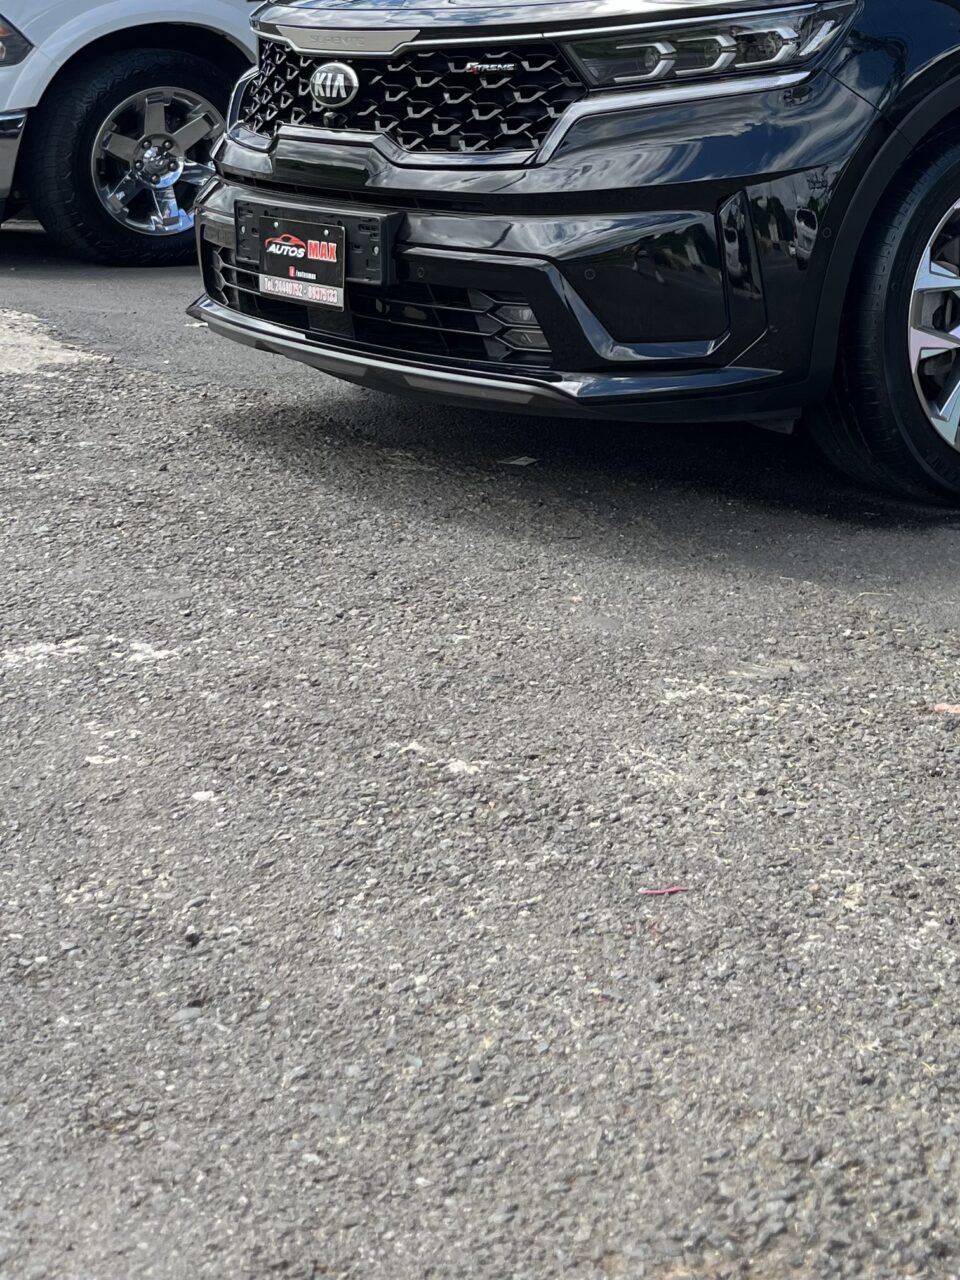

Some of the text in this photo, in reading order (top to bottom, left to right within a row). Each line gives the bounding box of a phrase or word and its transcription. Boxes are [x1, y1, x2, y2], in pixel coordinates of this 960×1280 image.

[313, 72, 348, 98] KIA
[267, 240, 337, 262] AUTOS MAX
